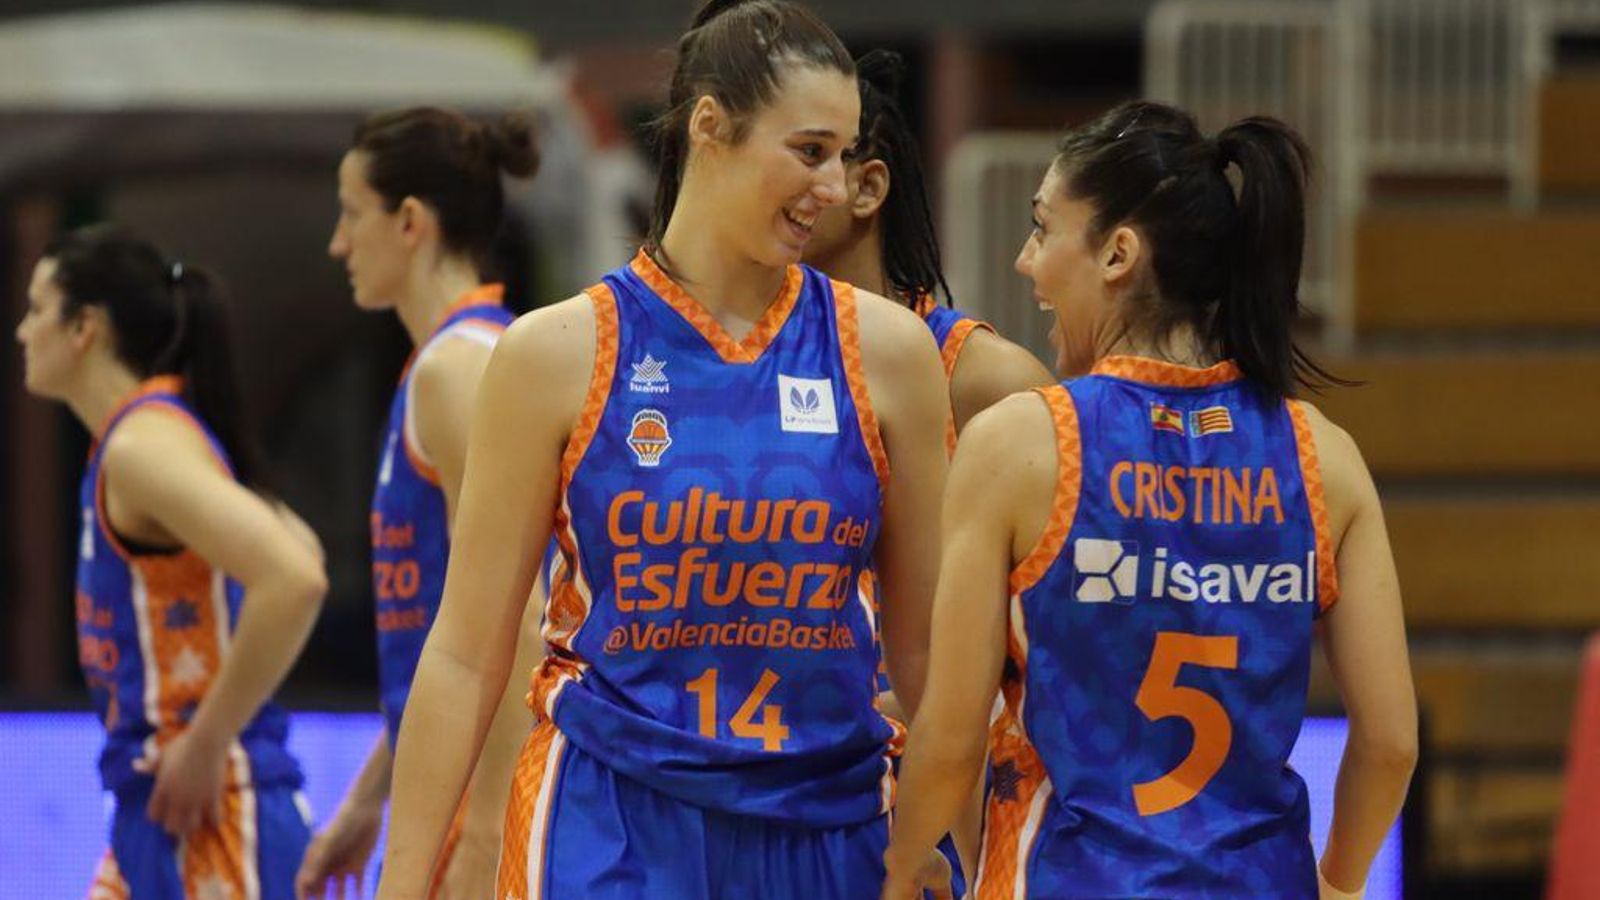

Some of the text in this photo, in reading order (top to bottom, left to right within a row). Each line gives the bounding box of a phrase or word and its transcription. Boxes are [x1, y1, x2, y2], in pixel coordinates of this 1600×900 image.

[630, 382, 670, 393] luanvi
[608, 487, 869, 547] Cultura del
[1110, 461, 1285, 524] CRISTINA
[613, 548, 851, 612] Esfuerzo
[1151, 547, 1315, 603] isaval
[603, 616, 856, 655] @ValenciaBaske
[686, 668, 789, 752] 14
[1133, 632, 1239, 816] 5
